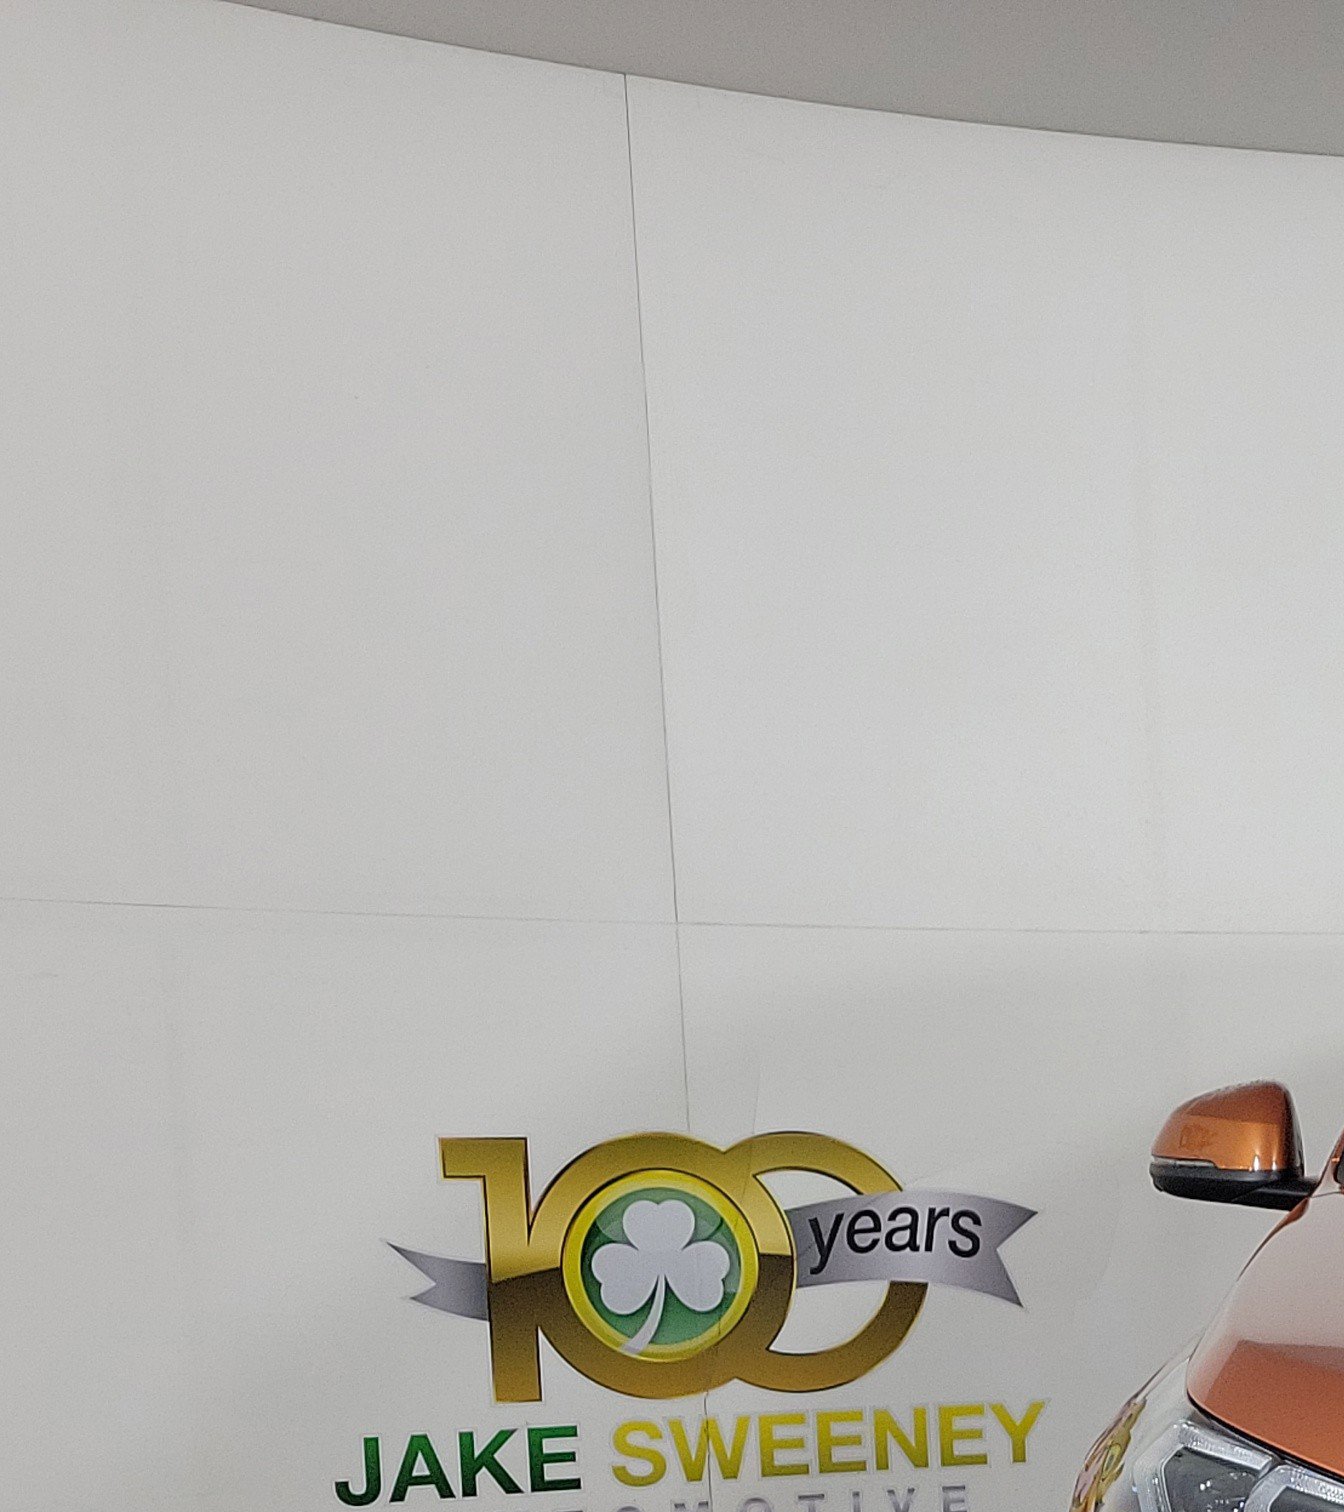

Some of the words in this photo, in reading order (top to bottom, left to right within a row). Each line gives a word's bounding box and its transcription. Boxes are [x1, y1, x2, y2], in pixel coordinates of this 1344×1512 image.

[438, 1131, 928, 1402] 100
[809, 1205, 982, 1275] years
[335, 1425, 582, 1506] JAKE
[611, 1401, 1046, 1487] SWEENEY
